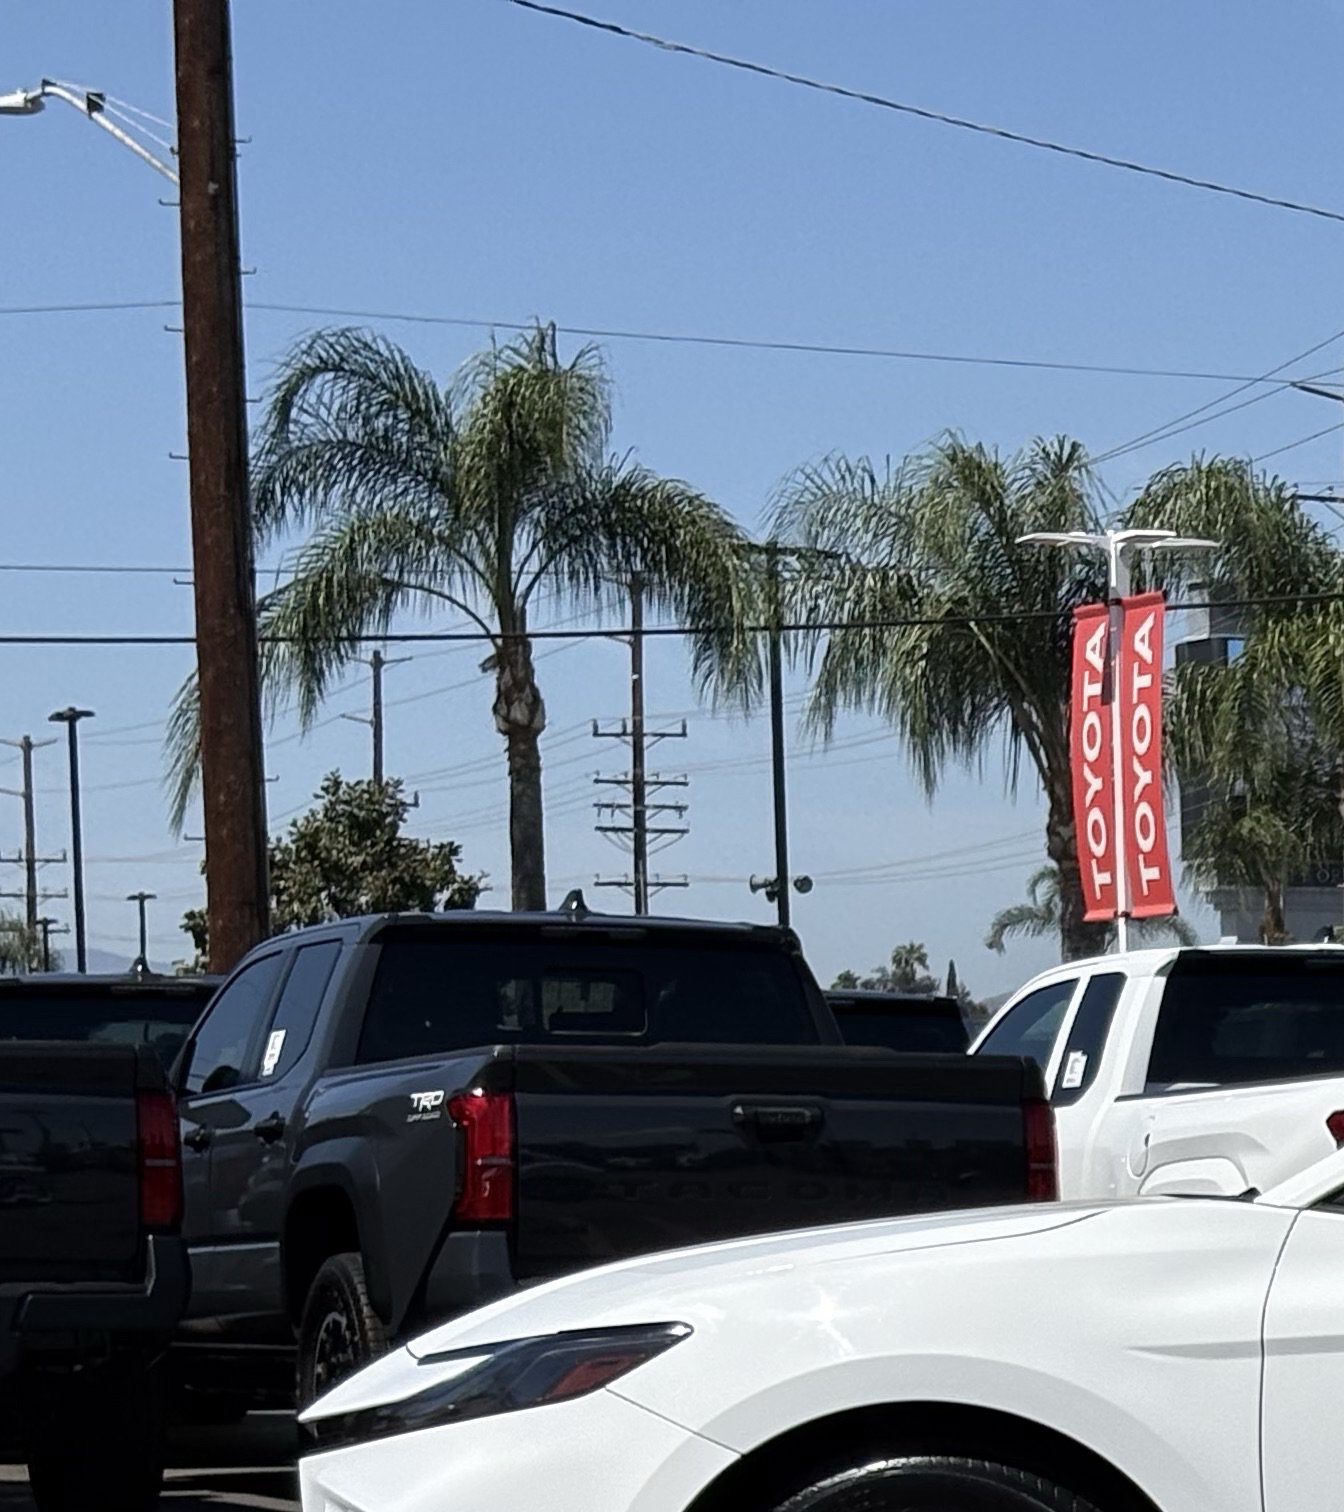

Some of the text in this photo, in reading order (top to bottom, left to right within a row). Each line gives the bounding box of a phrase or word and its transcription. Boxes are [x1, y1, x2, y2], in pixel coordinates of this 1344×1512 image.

[1082, 621, 1112, 900] TOYOTA
[1132, 611, 1161, 897] TOYOTA
[410, 1090, 445, 1112] TRD
